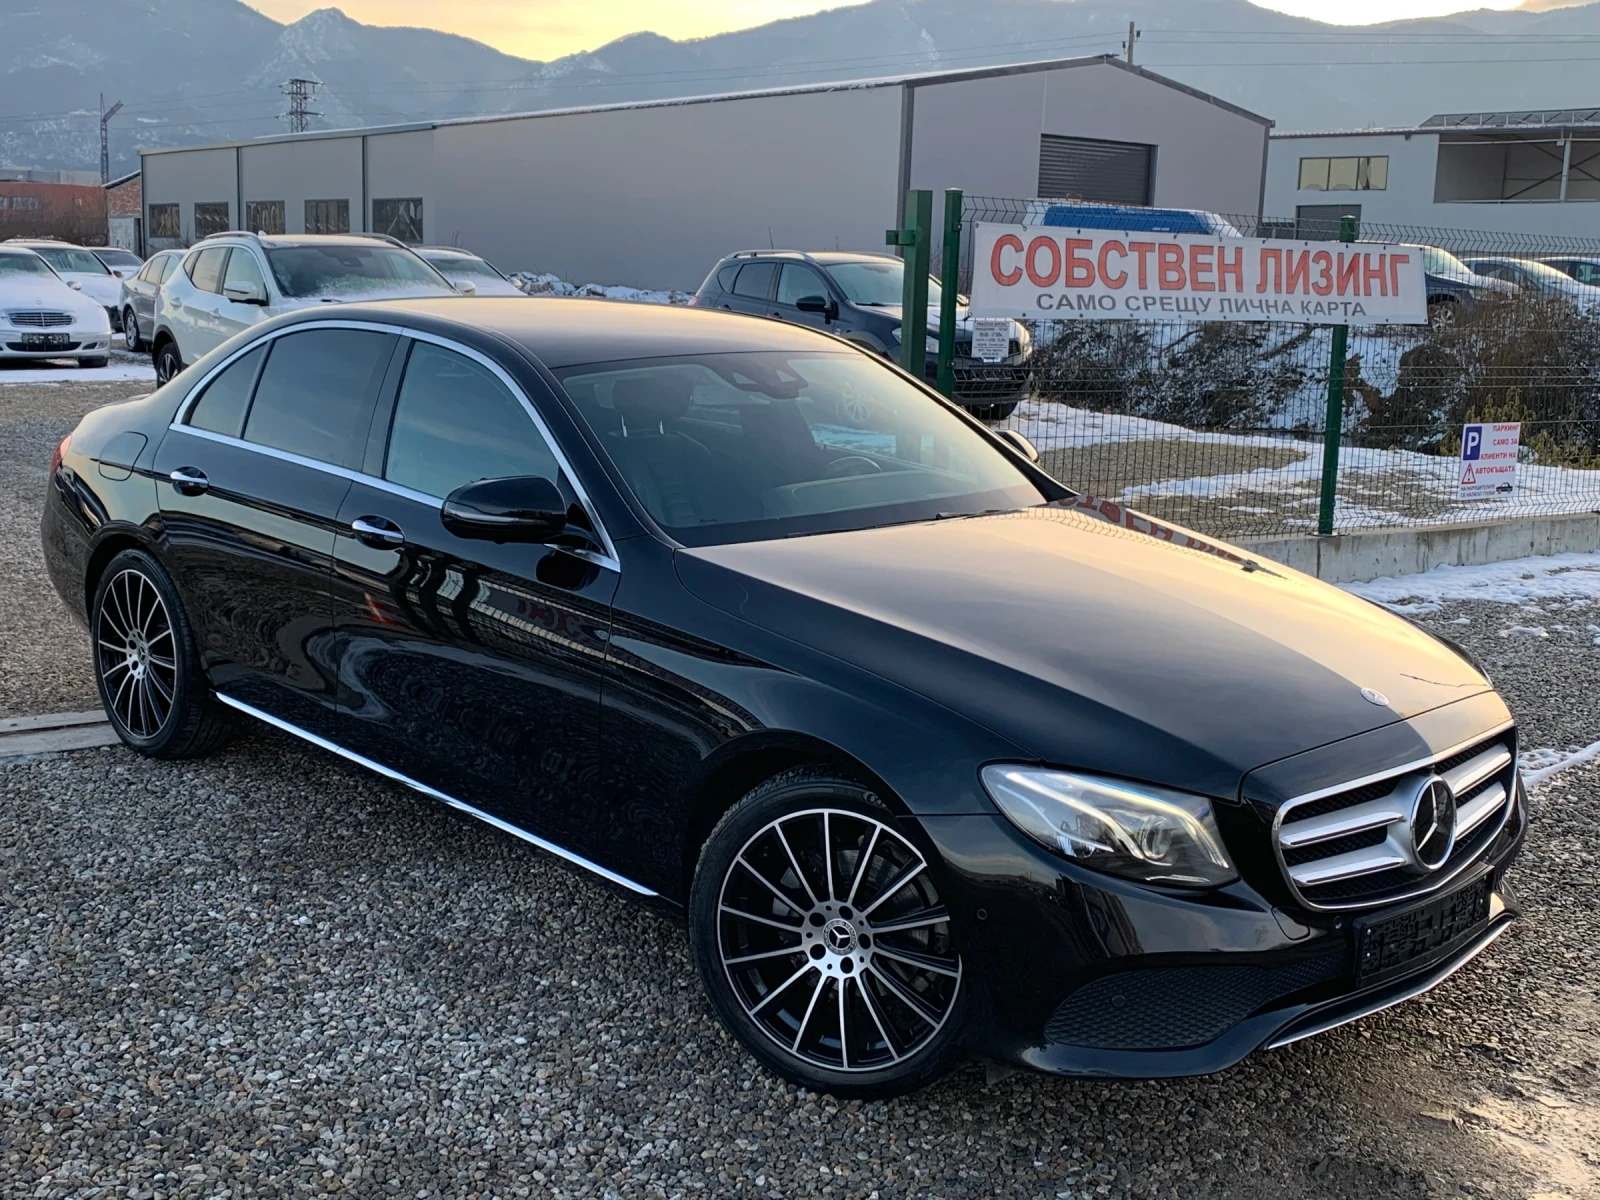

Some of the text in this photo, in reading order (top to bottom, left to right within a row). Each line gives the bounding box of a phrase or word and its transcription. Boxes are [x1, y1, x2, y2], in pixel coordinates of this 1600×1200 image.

[990, 233, 1411, 297] СОБСТВЕН ЛИЗИНГ
[1036, 293, 1367, 317] САМО СРЕЩУ ЛИЧНА КАРТА
[1467, 432, 1479, 455] P
[1475, 466, 1515, 475] АВТОКЪЩАТА
